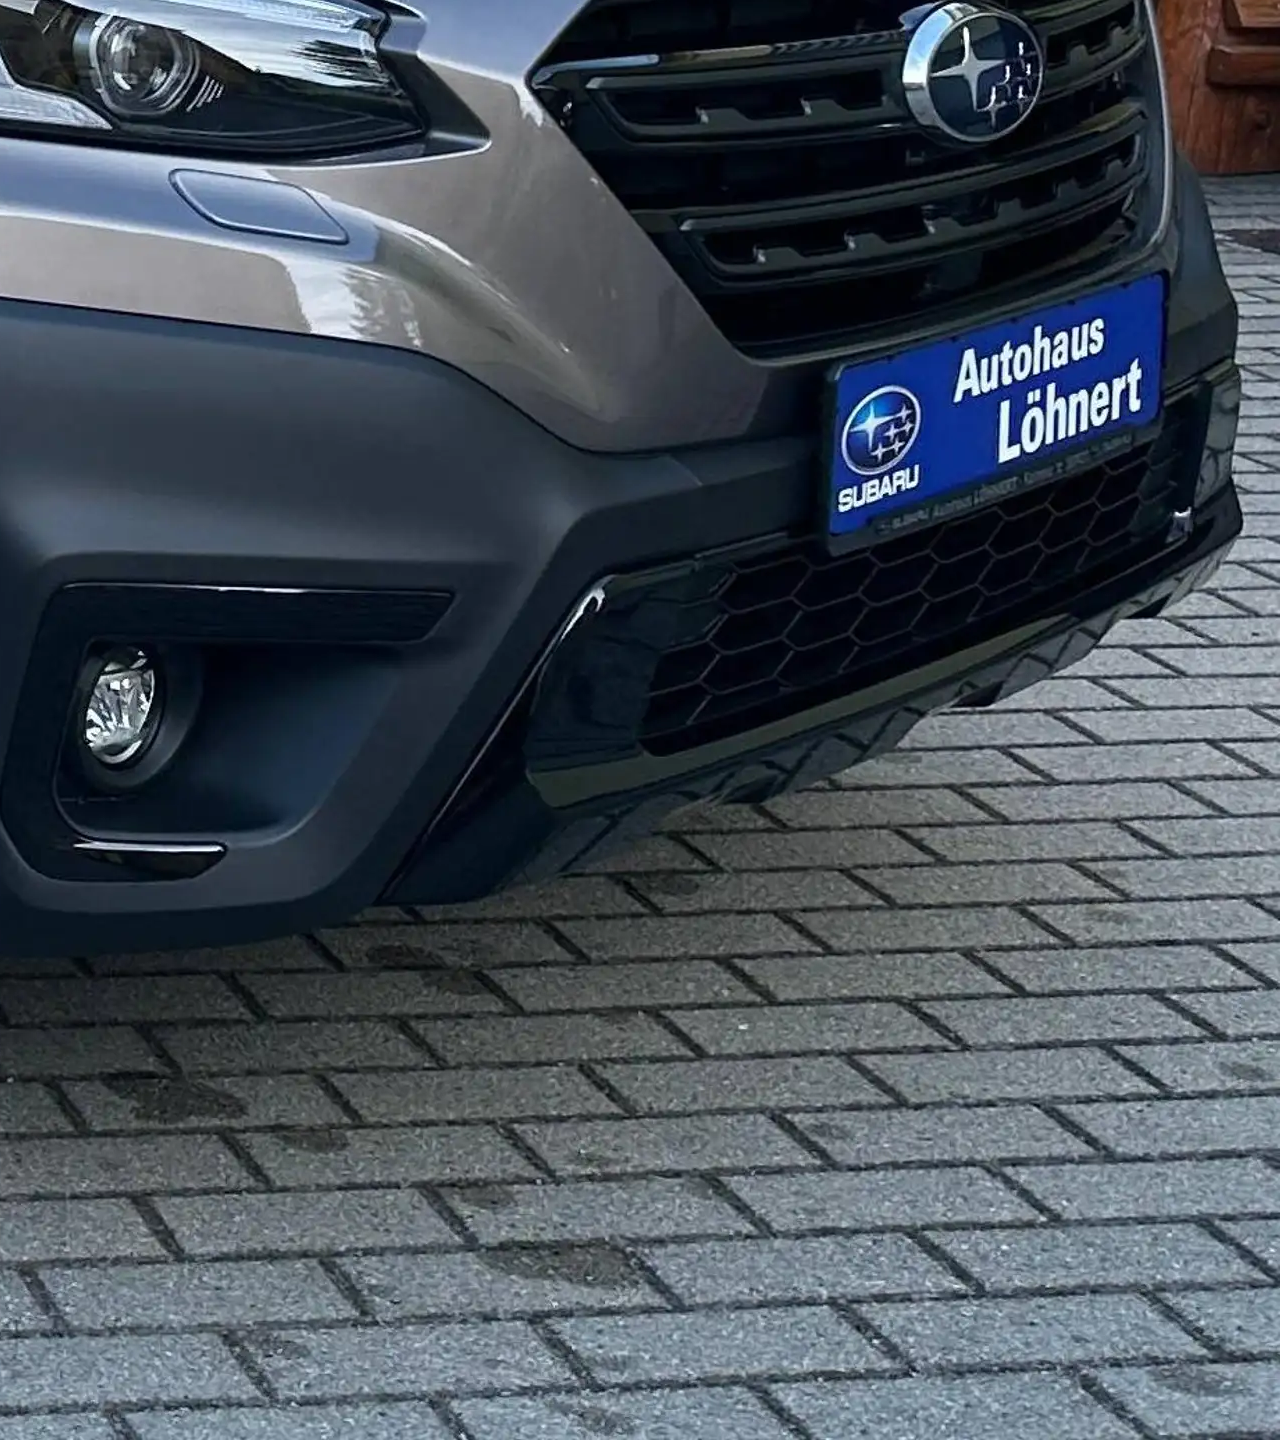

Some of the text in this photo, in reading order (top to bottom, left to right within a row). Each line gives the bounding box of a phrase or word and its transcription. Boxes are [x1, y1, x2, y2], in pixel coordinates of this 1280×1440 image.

[953, 317, 1106, 404] Autohaus
[997, 357, 1143, 464] Löhnert
[837, 464, 920, 513] SUBARU
